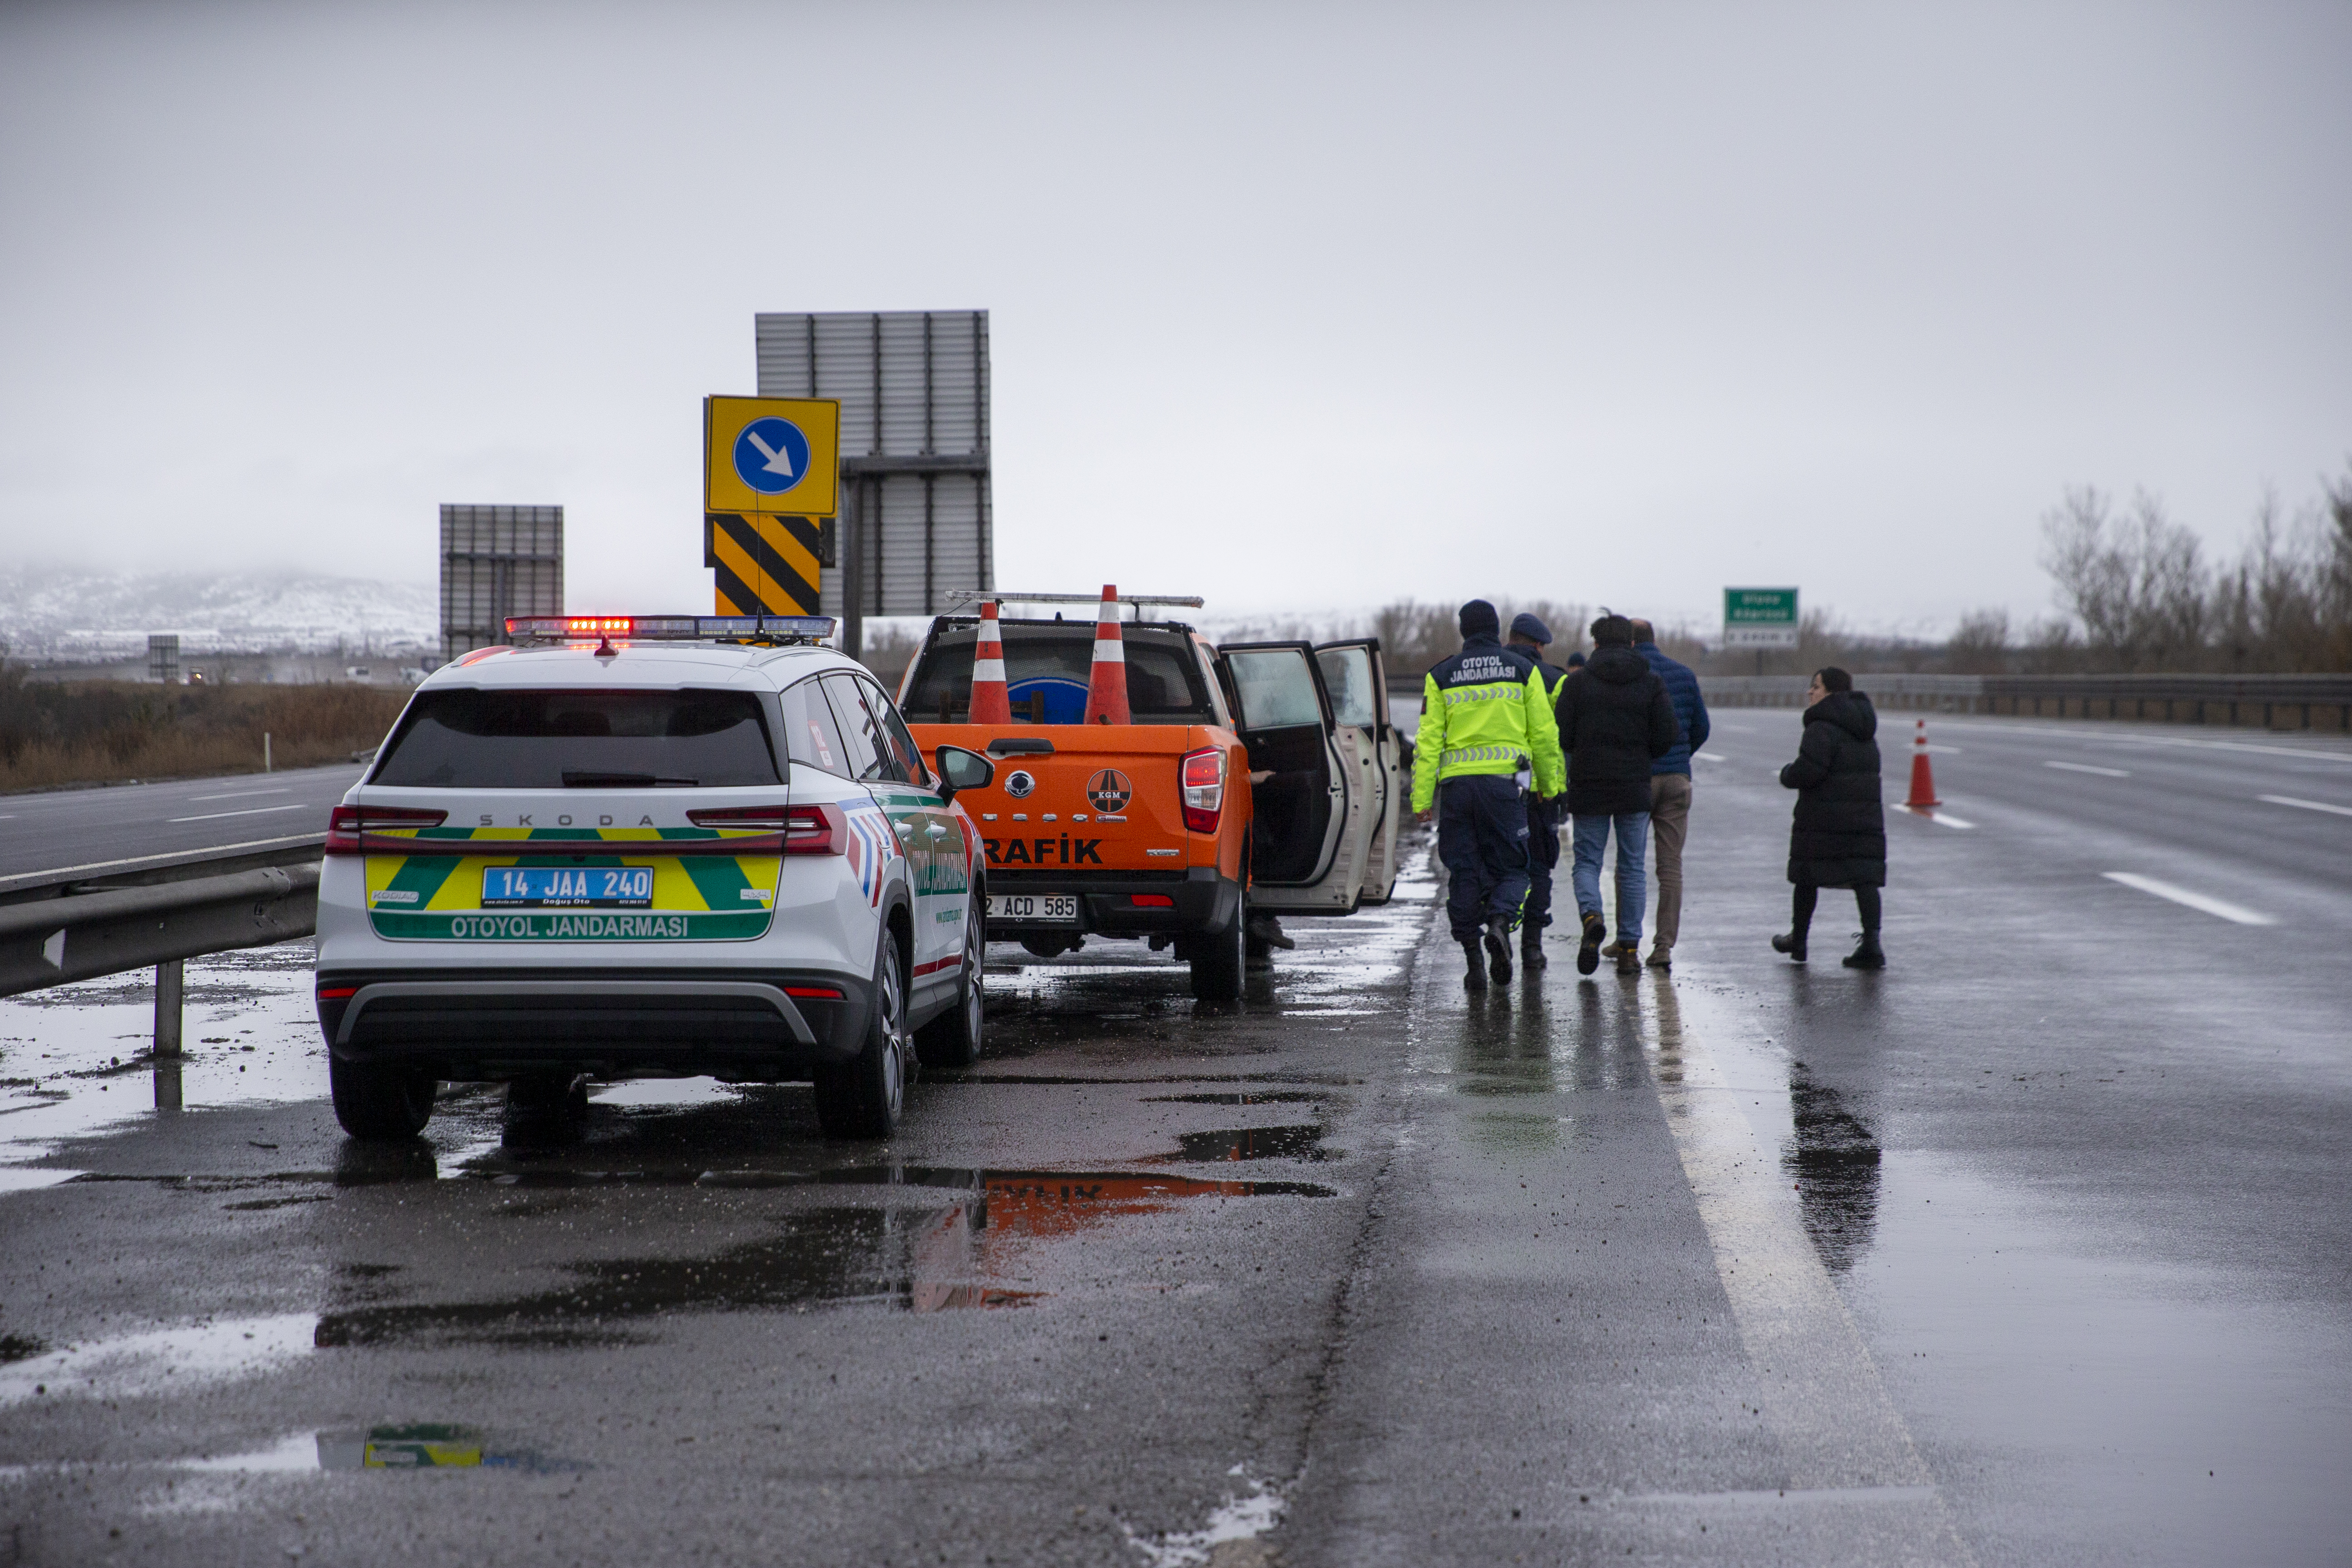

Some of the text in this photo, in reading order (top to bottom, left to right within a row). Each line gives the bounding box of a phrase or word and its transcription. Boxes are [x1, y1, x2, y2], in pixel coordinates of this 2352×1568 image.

[1462, 656, 1502, 669] OTOYOL
[1450, 666, 1516, 682] JANDARMASI
[480, 814, 654, 826] SKODA
[983, 833, 1103, 864] RAFİK
[503, 871, 648, 897] 14 JAA 240
[543, 898, 571, 906] Doğuş
[986, 897, 1075, 916] 2 ACD 585
[451, 916, 689, 937] OTOYOL JANDARMASI
